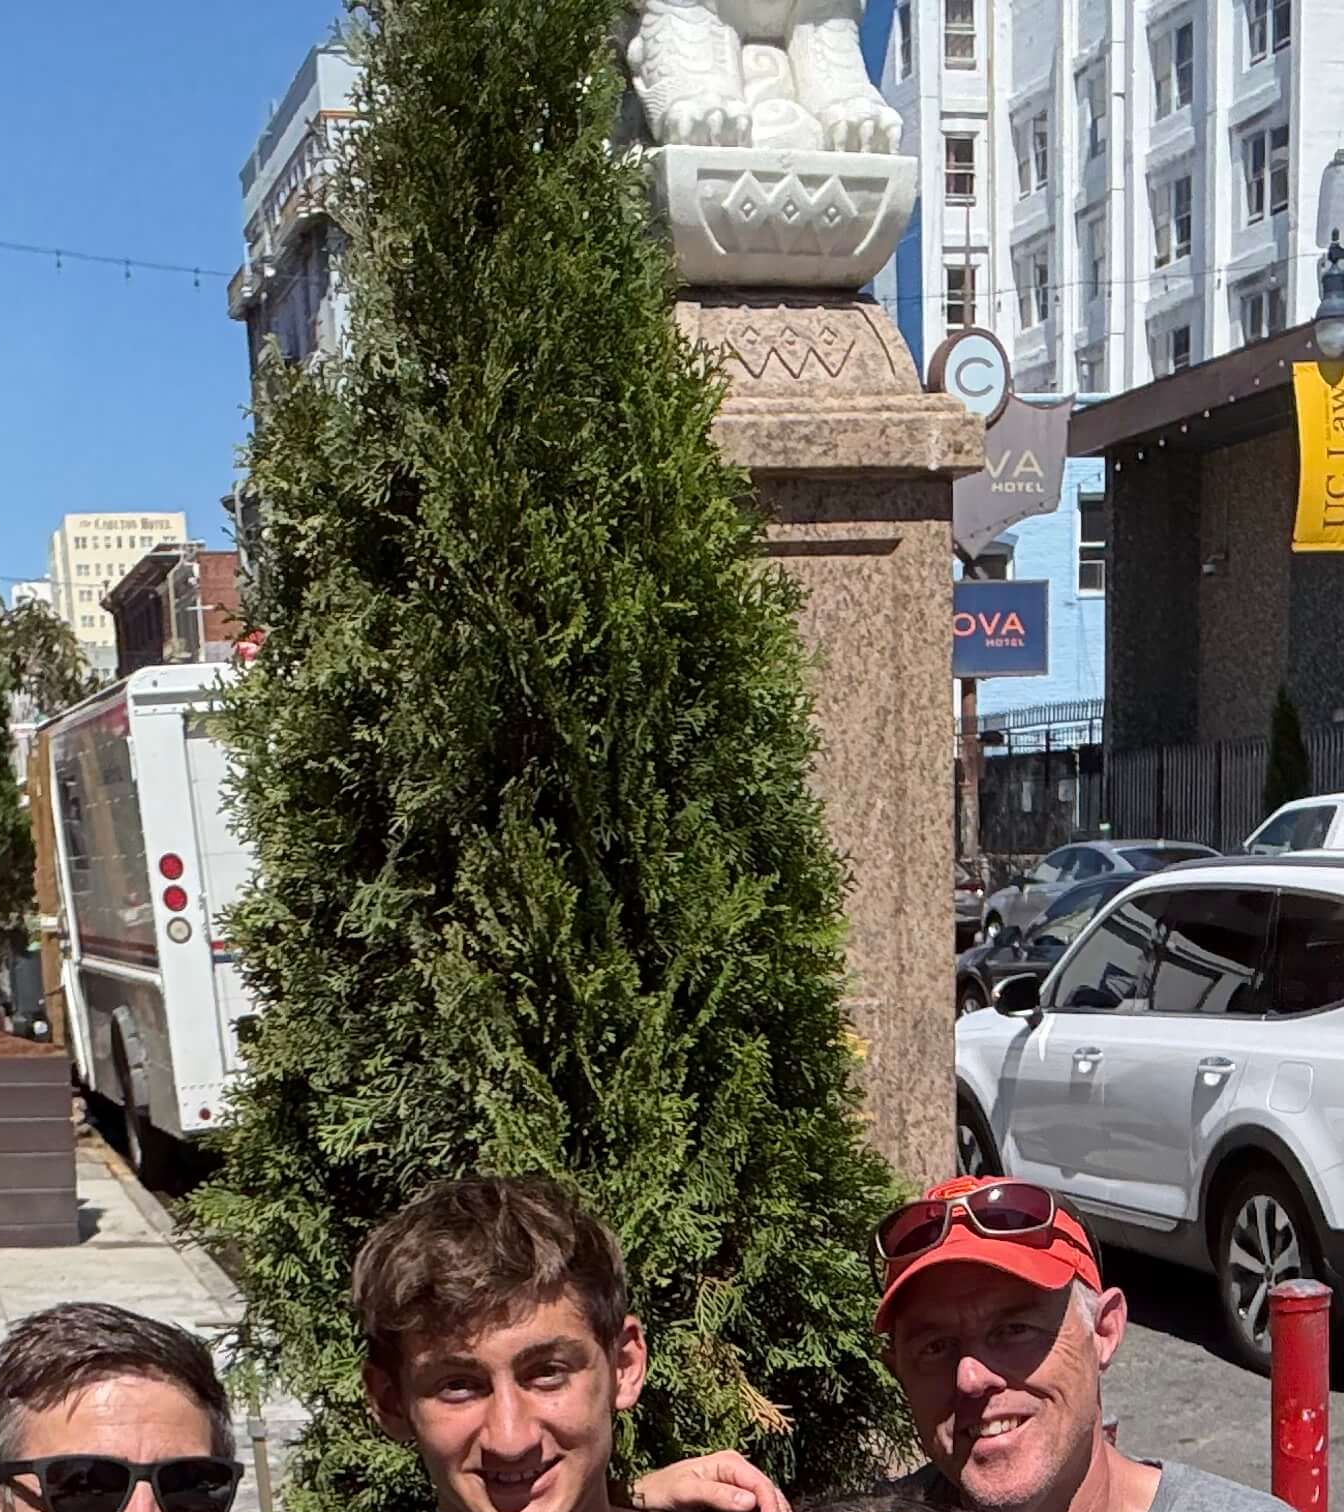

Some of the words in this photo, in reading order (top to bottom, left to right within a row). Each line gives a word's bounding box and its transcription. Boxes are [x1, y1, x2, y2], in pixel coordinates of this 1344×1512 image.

[985, 450, 1044, 478] VA
[992, 481, 1045, 493] HOTEL
[953, 612, 1025, 637] OVA
